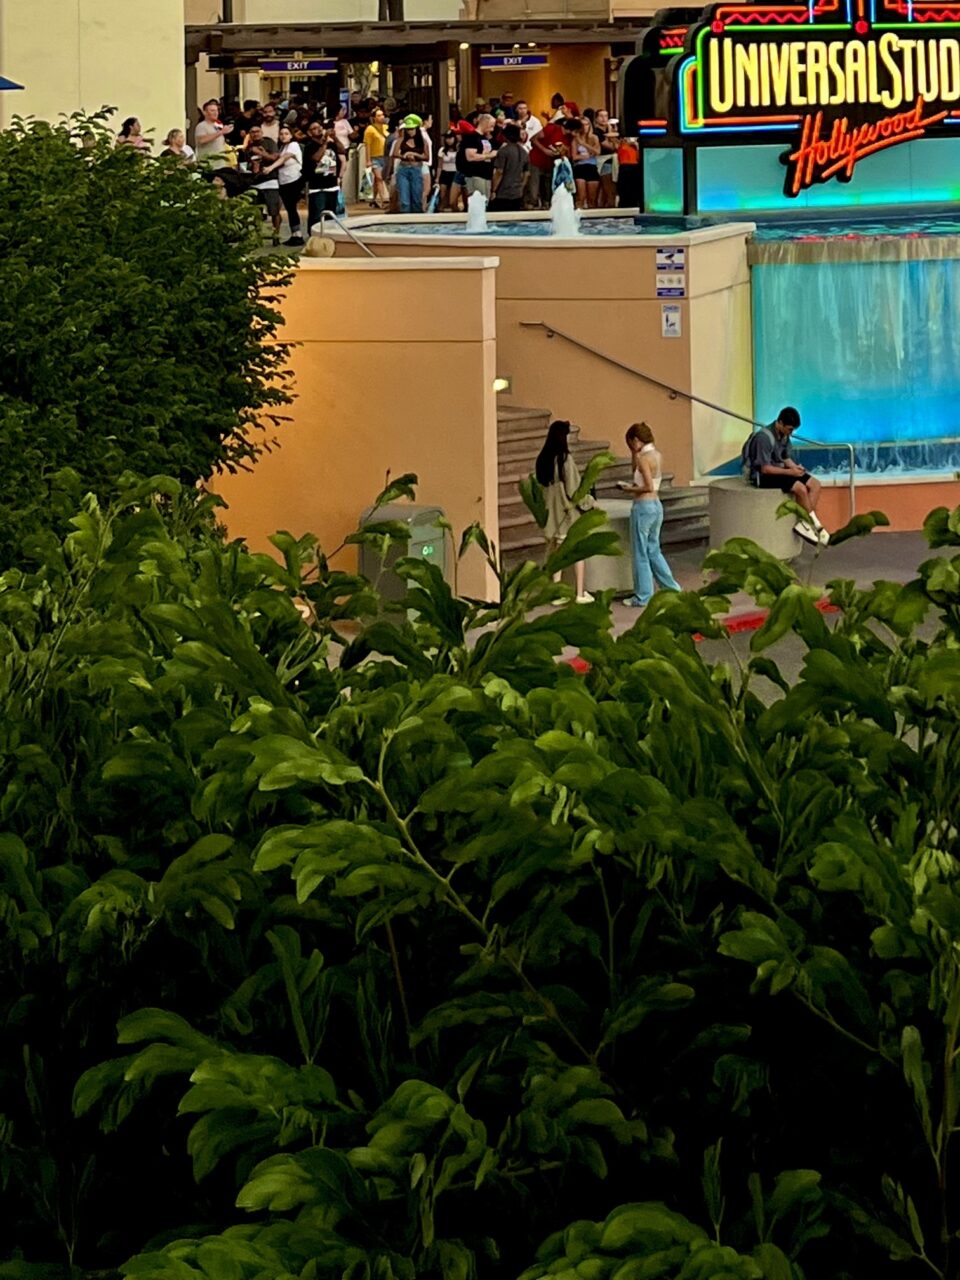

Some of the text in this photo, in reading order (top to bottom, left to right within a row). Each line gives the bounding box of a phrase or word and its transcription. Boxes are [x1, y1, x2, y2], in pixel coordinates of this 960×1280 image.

[286, 61, 310, 70] EXIT
[503, 56, 523, 66] EXIT
[788, 94, 950, 196] Hollywood
